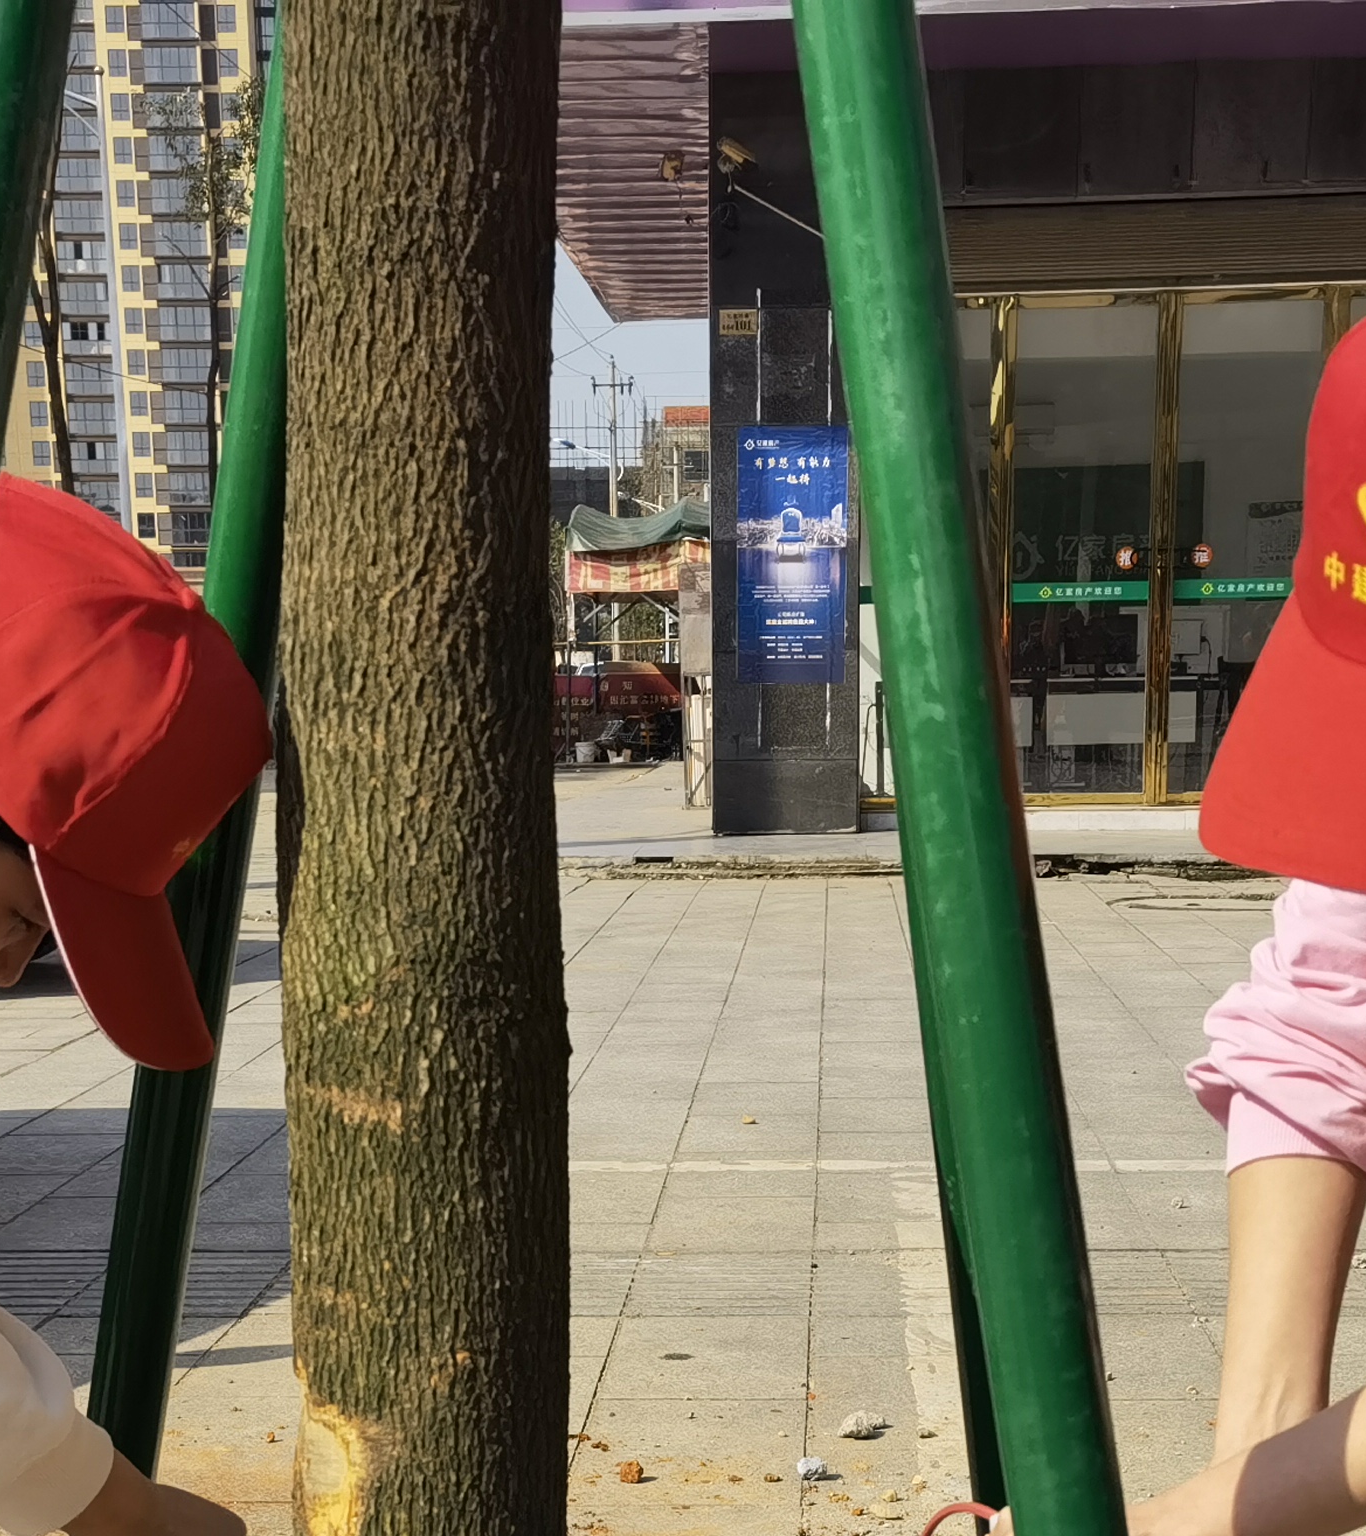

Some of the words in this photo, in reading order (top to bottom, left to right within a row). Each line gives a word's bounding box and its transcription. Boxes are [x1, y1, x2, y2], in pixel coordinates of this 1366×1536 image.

[1055, 586, 1122, 596] 亿家房产欢迎您
[1217, 583, 1284, 593] 亿家房产欢迎您
